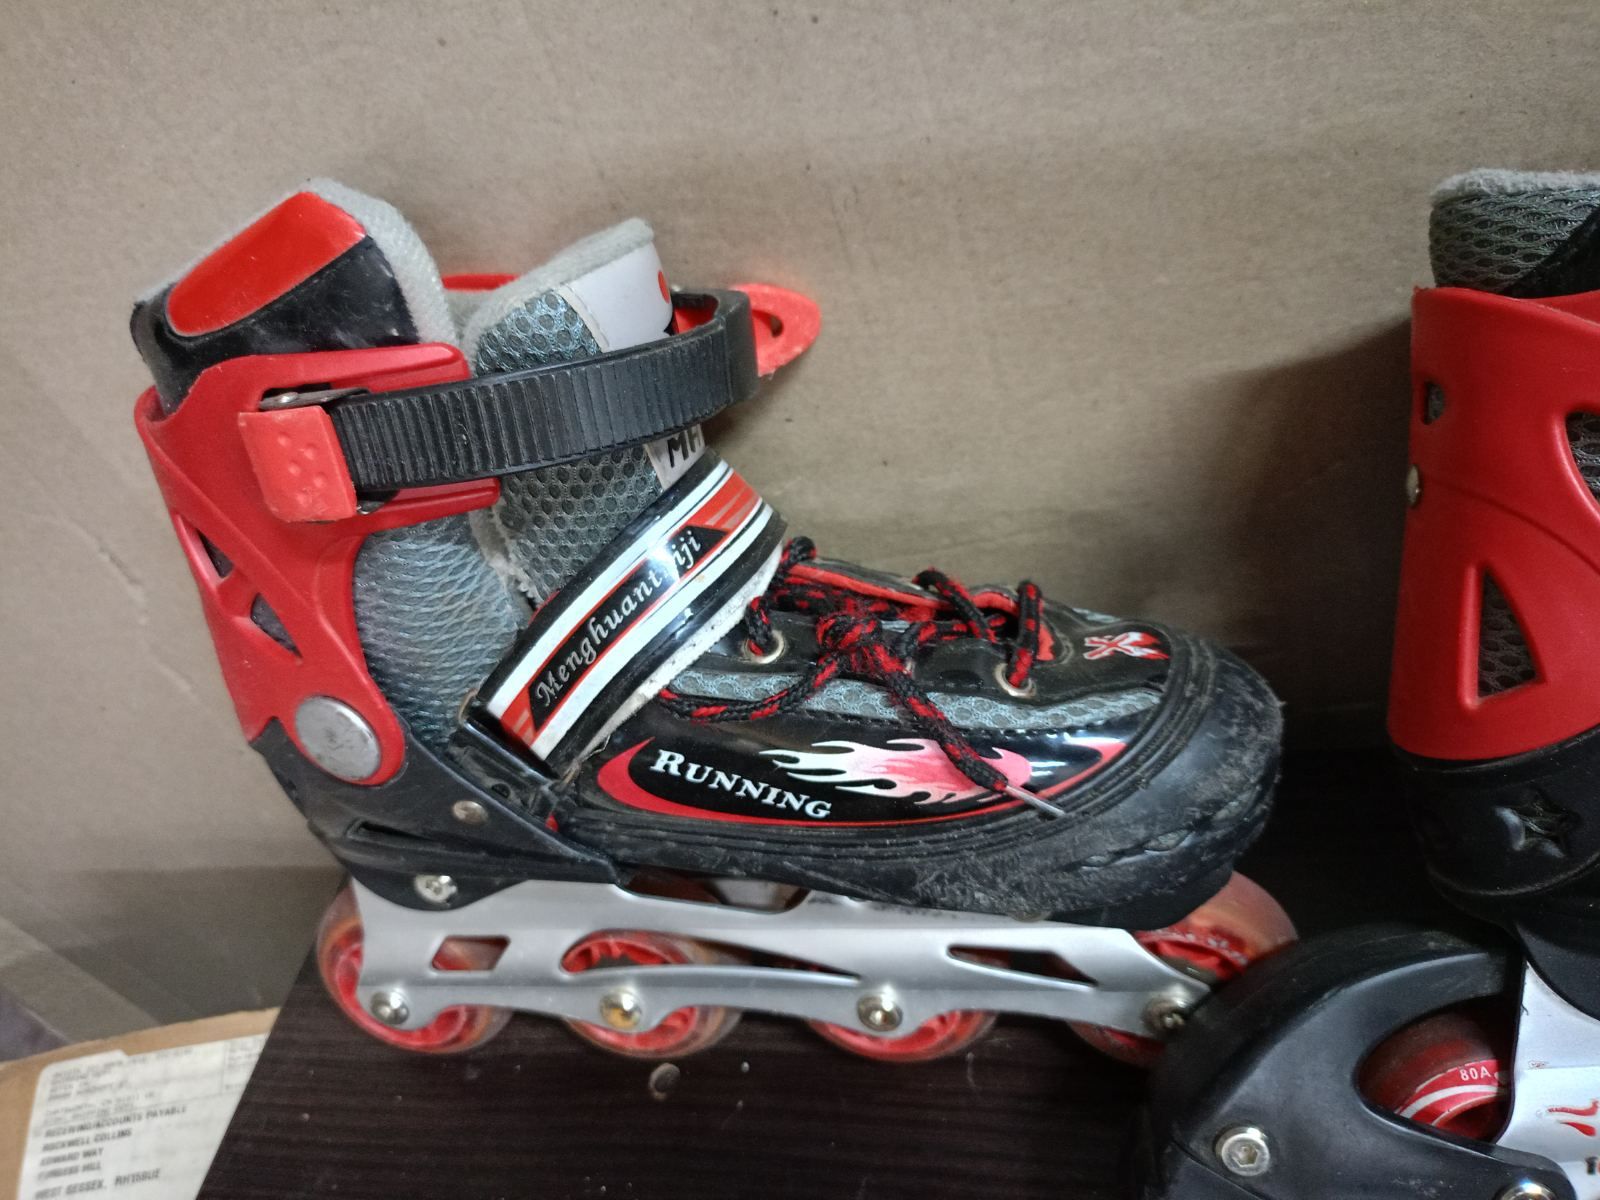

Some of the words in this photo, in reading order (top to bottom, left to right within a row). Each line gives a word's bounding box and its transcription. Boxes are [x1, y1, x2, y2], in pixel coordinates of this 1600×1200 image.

[534, 529, 702, 707] Menghuantiji
[650, 749, 832, 819] RUNNING
[1460, 1066, 1491, 1082] 80A
